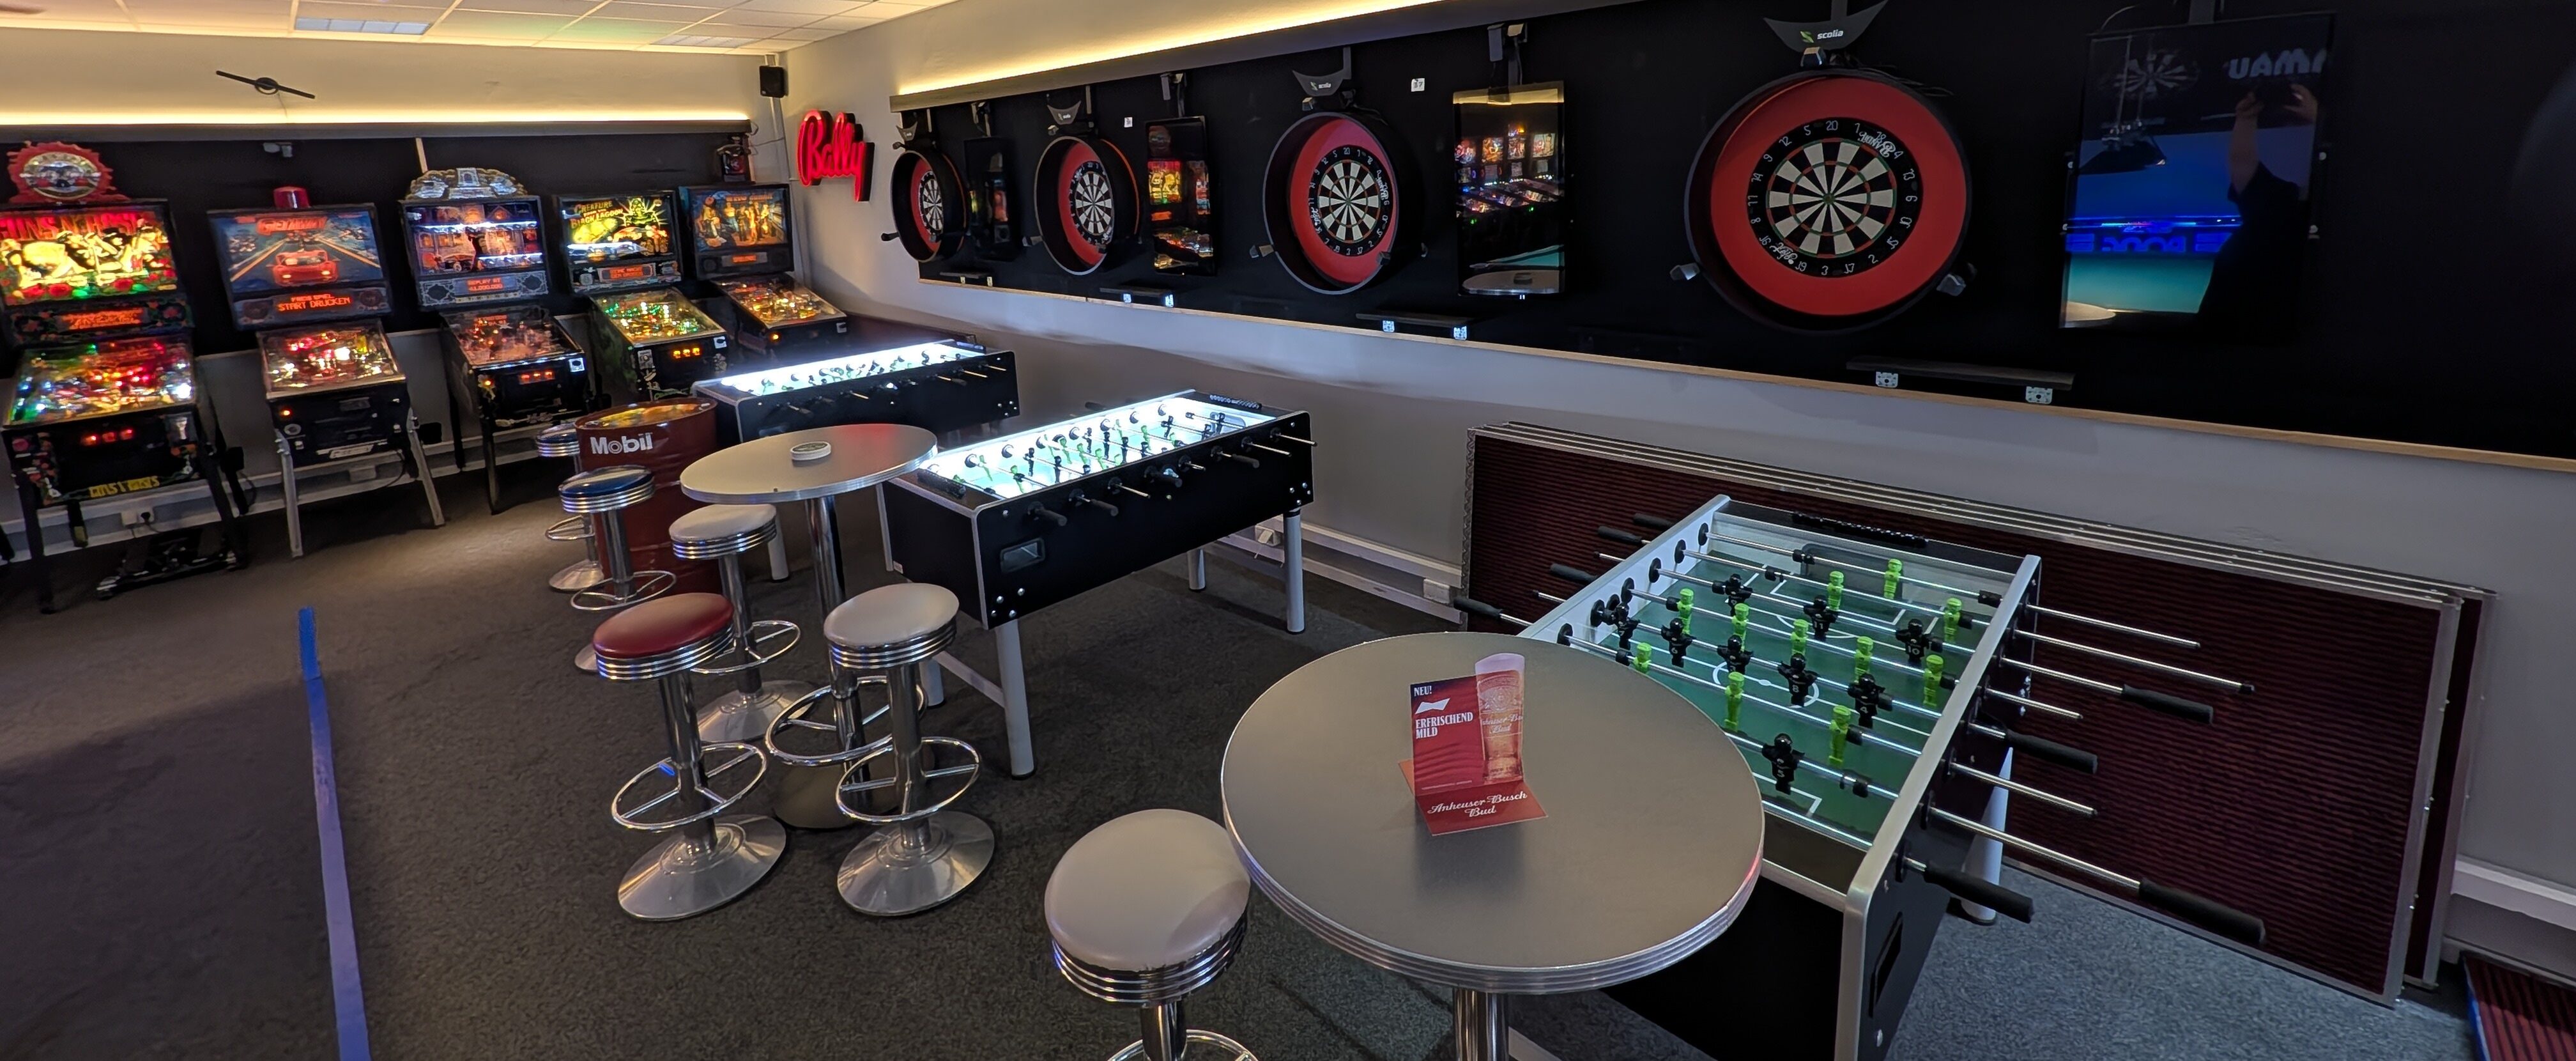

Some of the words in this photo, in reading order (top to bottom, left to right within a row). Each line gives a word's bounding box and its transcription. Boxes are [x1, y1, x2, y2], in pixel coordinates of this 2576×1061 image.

[1817, 29, 1844, 40] scolia
[1804, 124, 1811, 136] 5
[1825, 120, 1839, 131] 20
[1779, 136, 1793, 147] 12
[797, 108, 867, 203] Bally
[1343, 147, 1351, 155] 20
[1763, 153, 1773, 162] 9
[574, 200, 613, 214] CREATURE
[570, 213, 595, 229] BLACK
[595, 208, 624, 221] LAGOON
[1759, 235, 1772, 246] 16
[1867, 254, 1879, 264] 2
[1795, 260, 1807, 272] 19
[1821, 265, 1829, 276] 3
[1843, 262, 1855, 274] 17
[278, 302, 306, 312] START
[590, 432, 654, 454] Mobil
[1814, 621, 1823, 630] 11
[1908, 646, 1920, 655] 10
[1414, 685, 1432, 697] NEU!
[1791, 685, 1799, 693] 8
[1860, 706, 1867, 714] 4
[1415, 711, 1474, 729] ERFRISCHEND
[1416, 727, 1438, 740] MILD
[1777, 769, 1785, 778] 5
[1427, 791, 1528, 814] Anheuser-Busch
[1464, 805, 1497, 817] Bud
